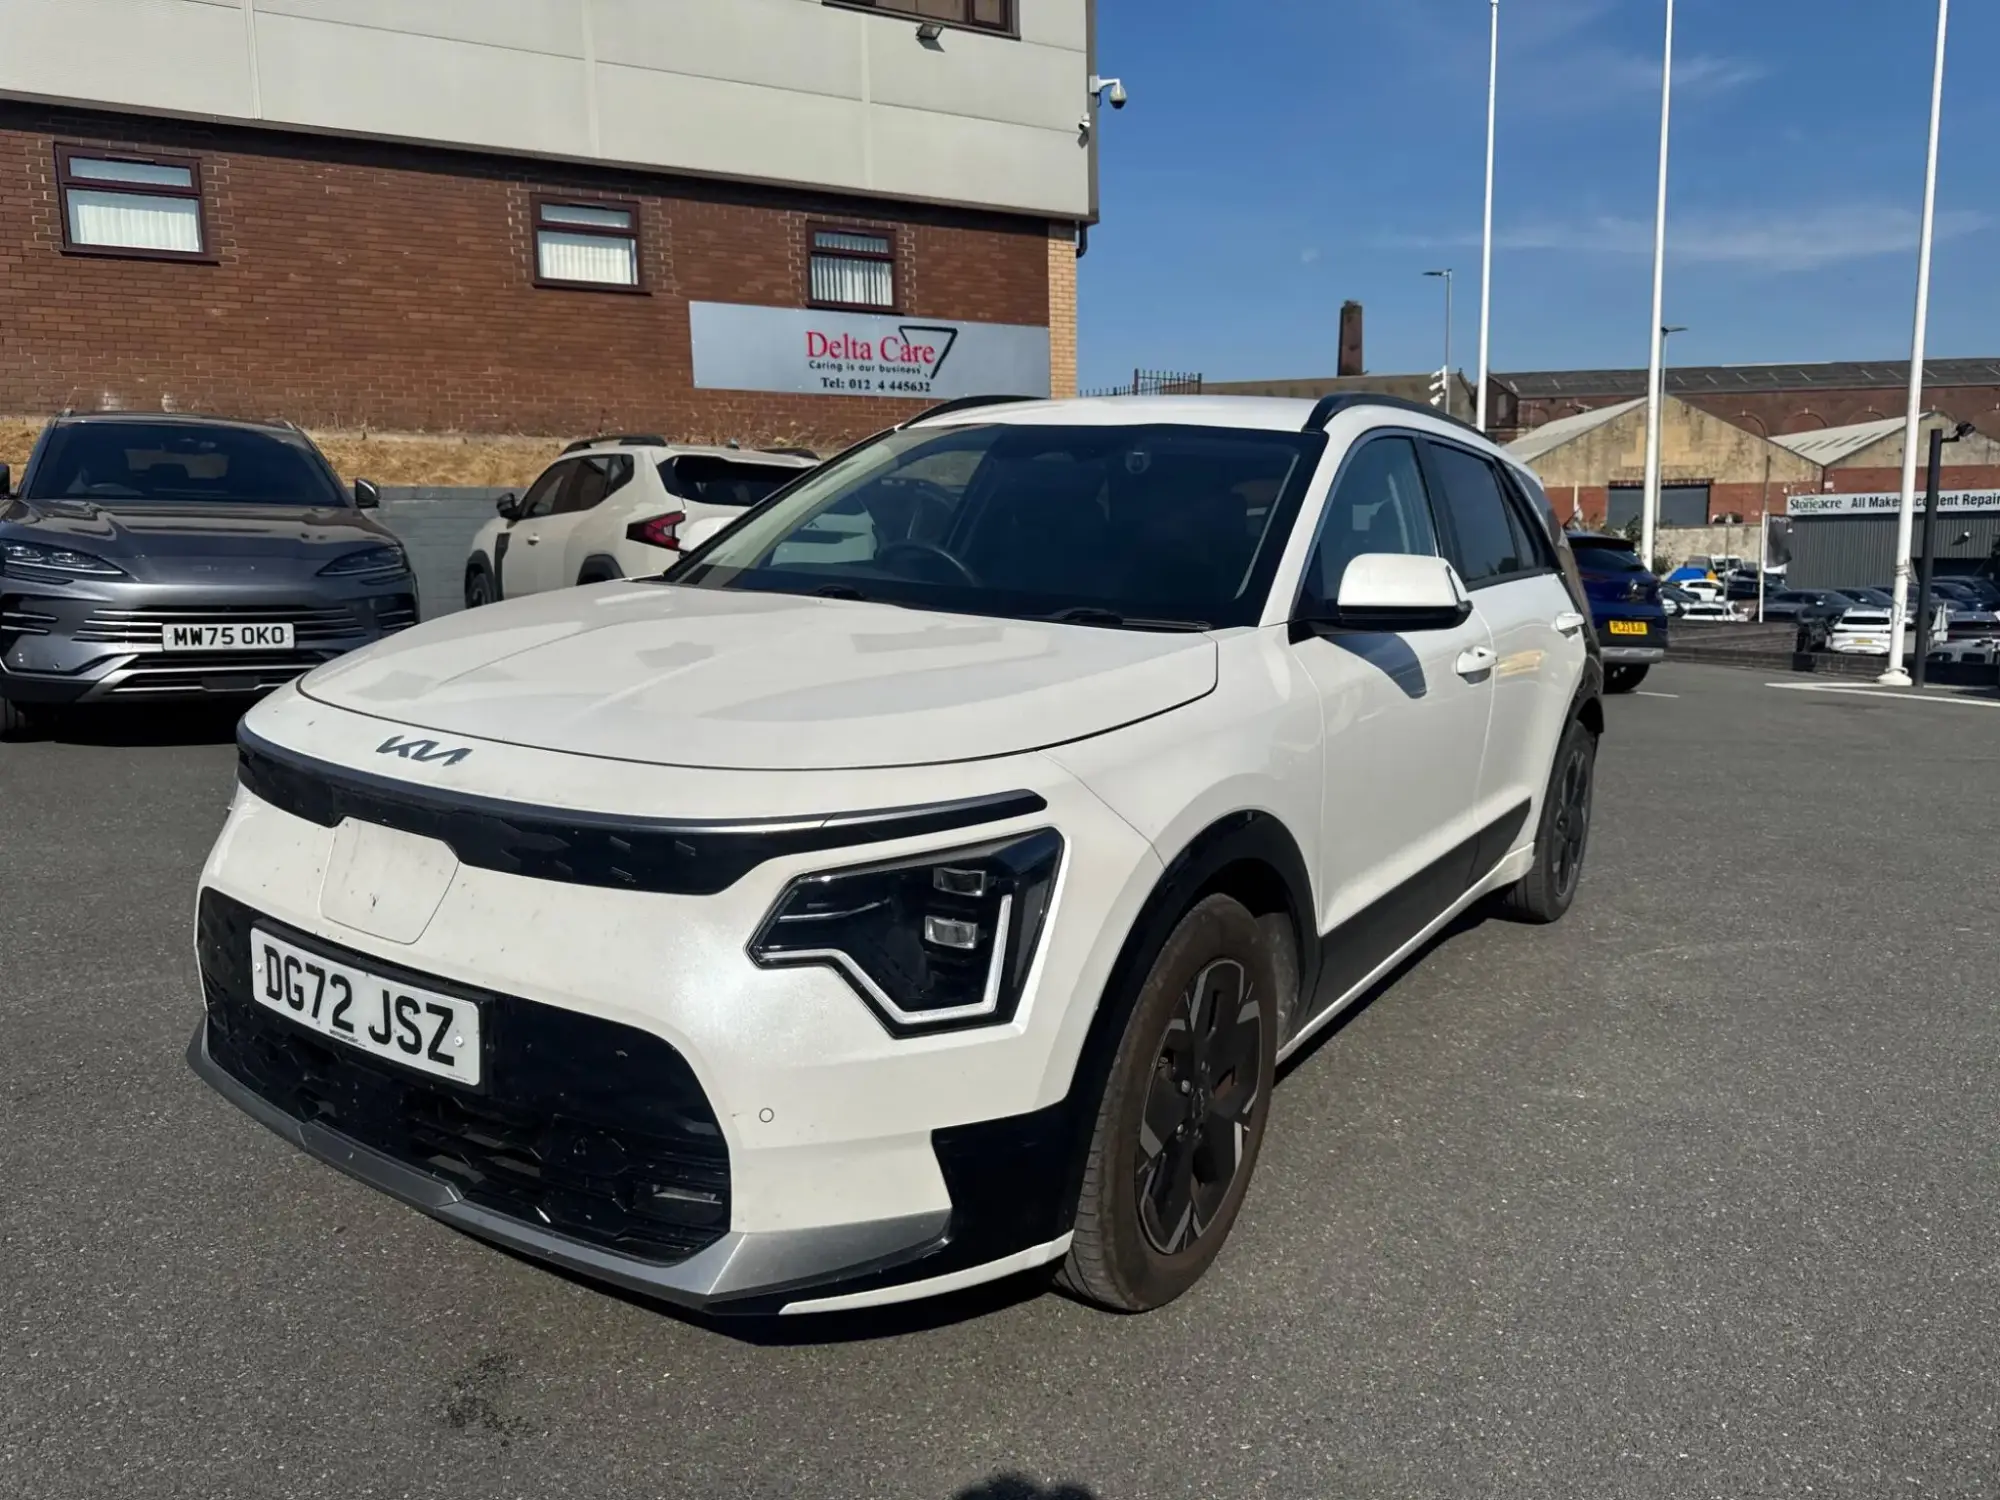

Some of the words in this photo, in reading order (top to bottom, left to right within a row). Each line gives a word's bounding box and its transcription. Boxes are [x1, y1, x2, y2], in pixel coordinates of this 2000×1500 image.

[806, 331, 873, 361] Delta
[880, 336, 936, 364] Care
[808, 360, 843, 372] Caring
[846, 363, 855, 372] is
[858, 364, 875, 372] our
[879, 364, 921, 374] business
[820, 377, 845, 388] Tel:
[849, 379, 871, 390] 012
[877, 380, 885, 390] 4
[889, 381, 931, 392] 445632
[1790, 497, 1842, 510] Stoneacre
[1851, 497, 1866, 508] All
[173, 627, 235, 646] MW75
[241, 626, 285, 645] OKO
[264, 944, 354, 1034] DG72
[368, 989, 455, 1067] JSZ
